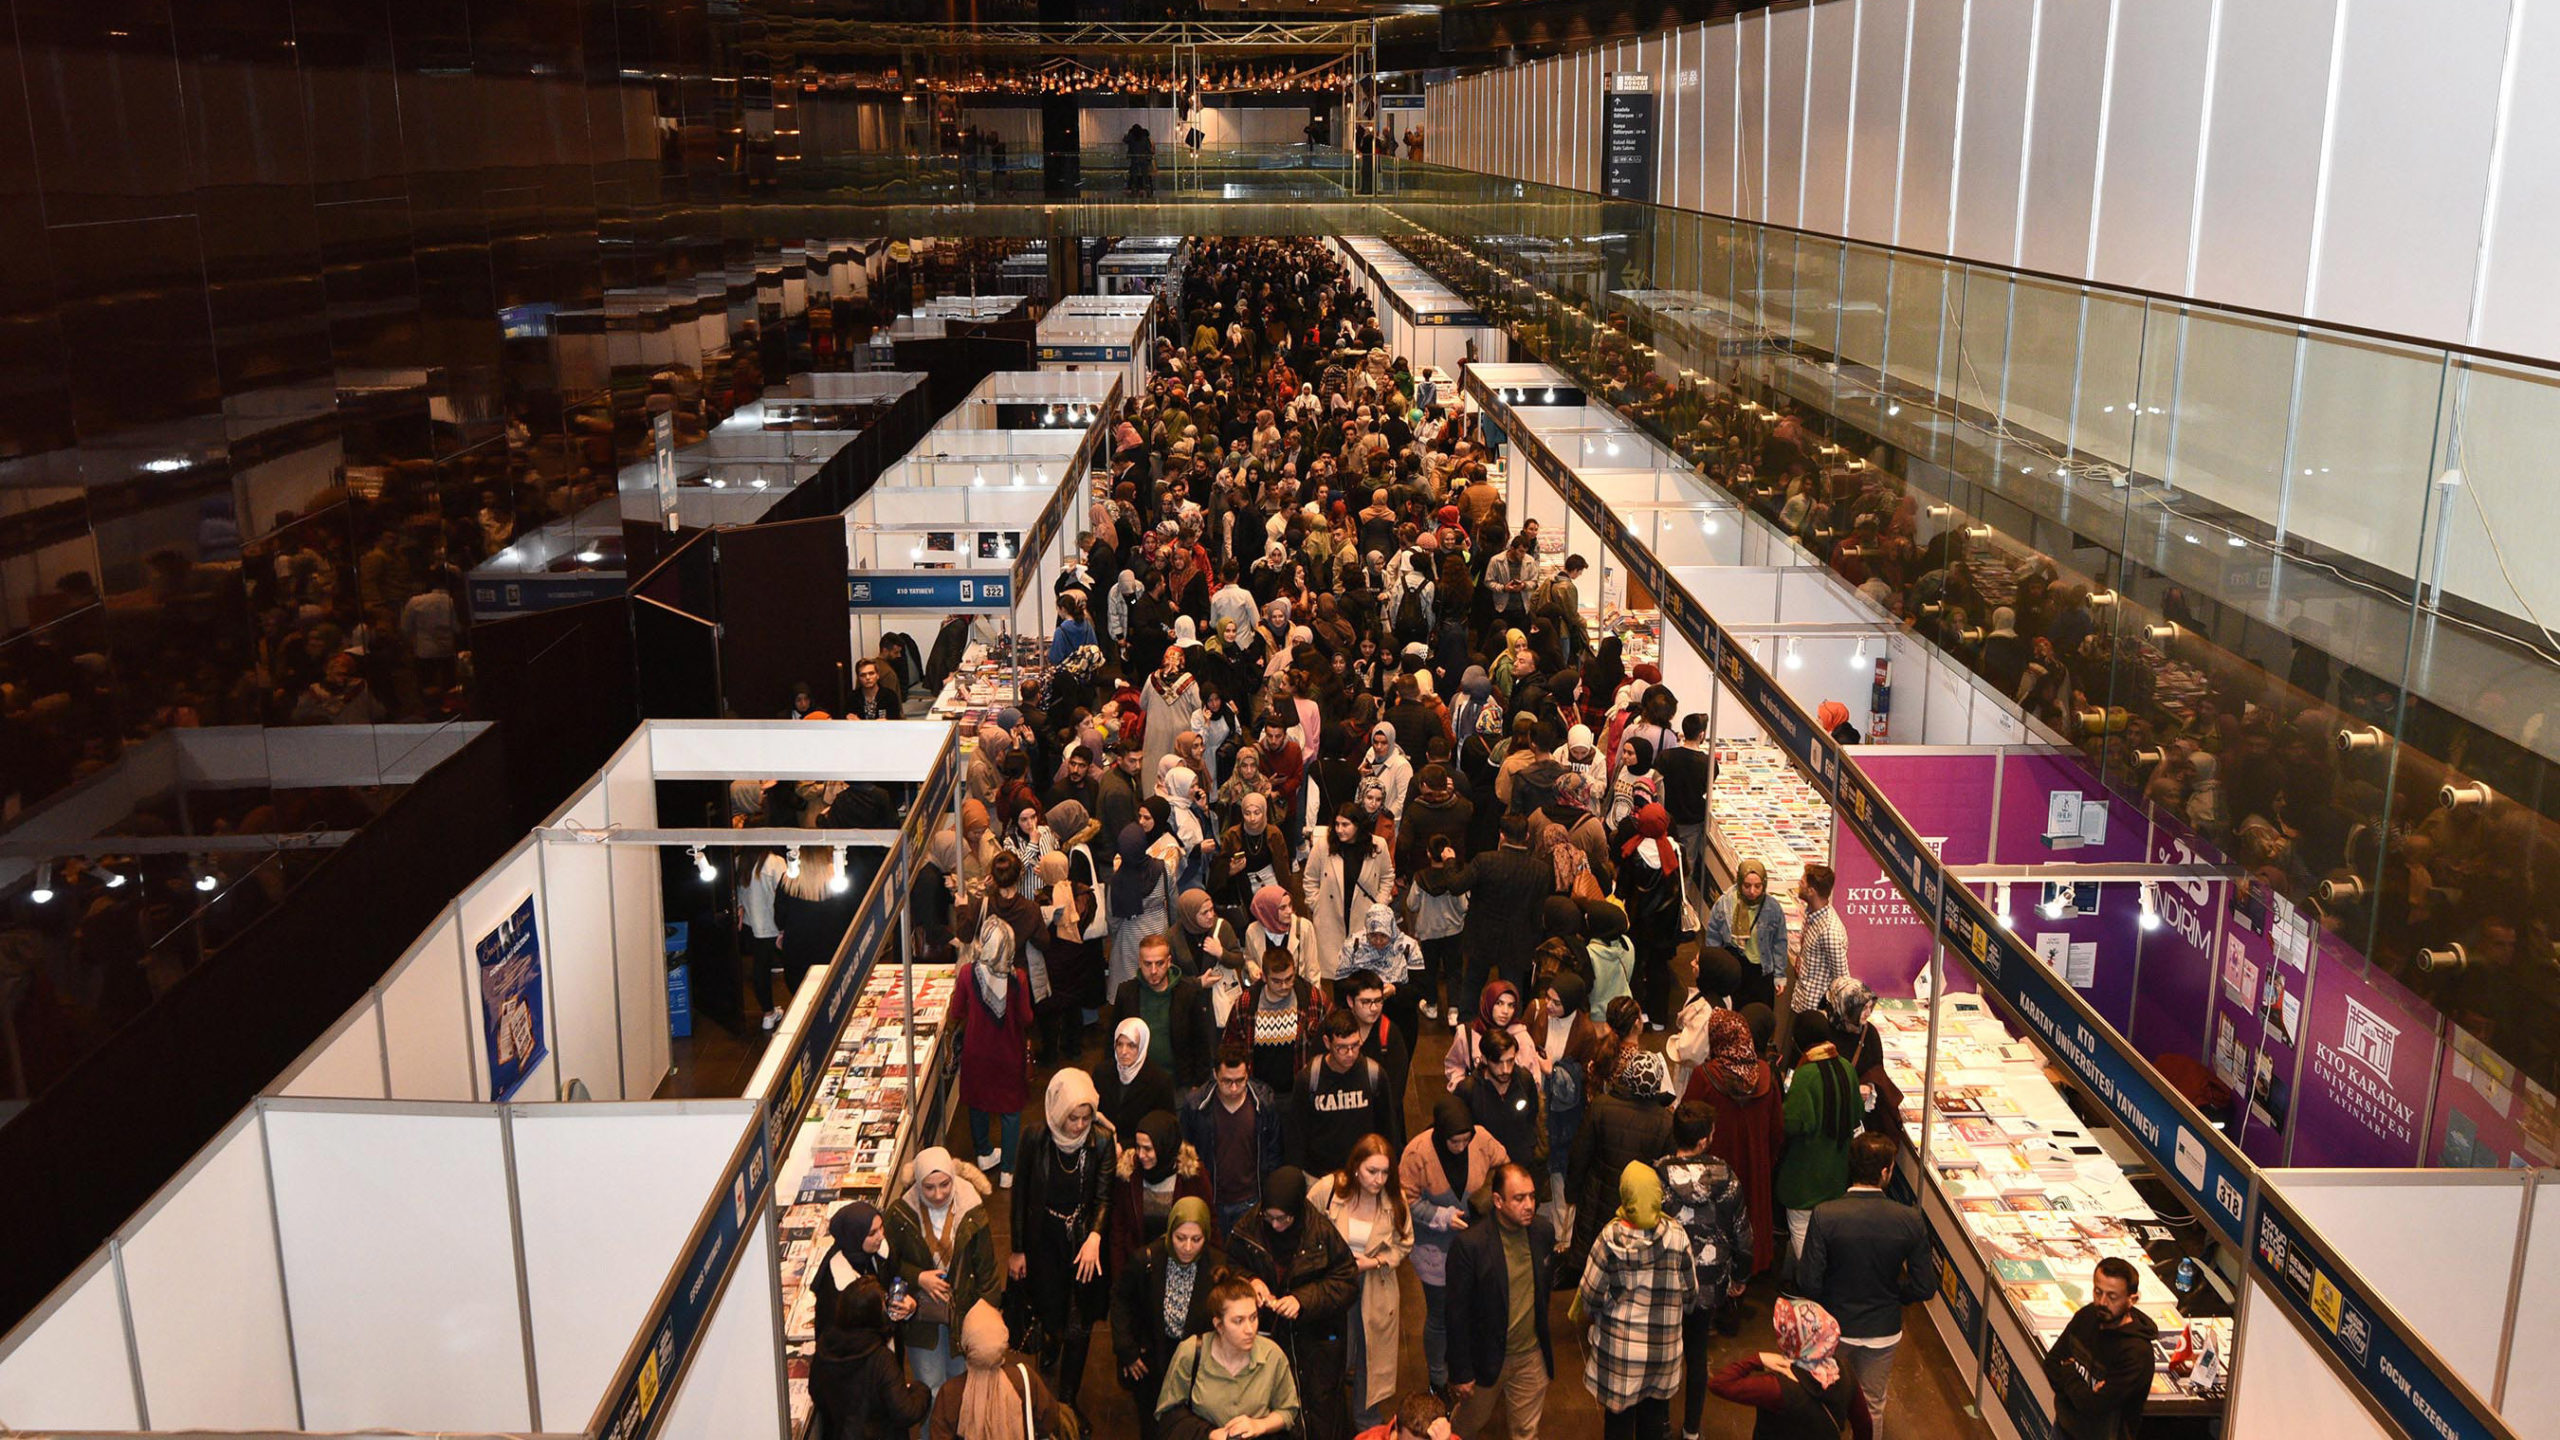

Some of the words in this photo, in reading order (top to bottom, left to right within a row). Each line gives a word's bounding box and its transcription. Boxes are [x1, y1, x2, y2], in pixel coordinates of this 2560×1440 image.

[985, 587, 1002, 597] 322
[1846, 902, 1917, 915] ÜNİVER
[1847, 888, 1886, 901] KTO
[2077, 1023, 2096, 1054] KTO
[2019, 991, 2055, 1038] KARATAY
[2055, 1023, 2115, 1101] ÜNİVERSİTESİ
[2116, 1089, 2160, 1148] YAYINEVİ
[2315, 1041, 2346, 1074] KTO
[2348, 1065, 2415, 1125] KARATAY
[2314, 1059, 2412, 1145] ÜNİVERSİTESİ
[2328, 1088, 2388, 1140] YAYINLARI
[2219, 1186, 2239, 1217] 318
[2261, 1222, 2286, 1258] kitap
[2379, 1355, 2412, 1399] ÇOCUK
